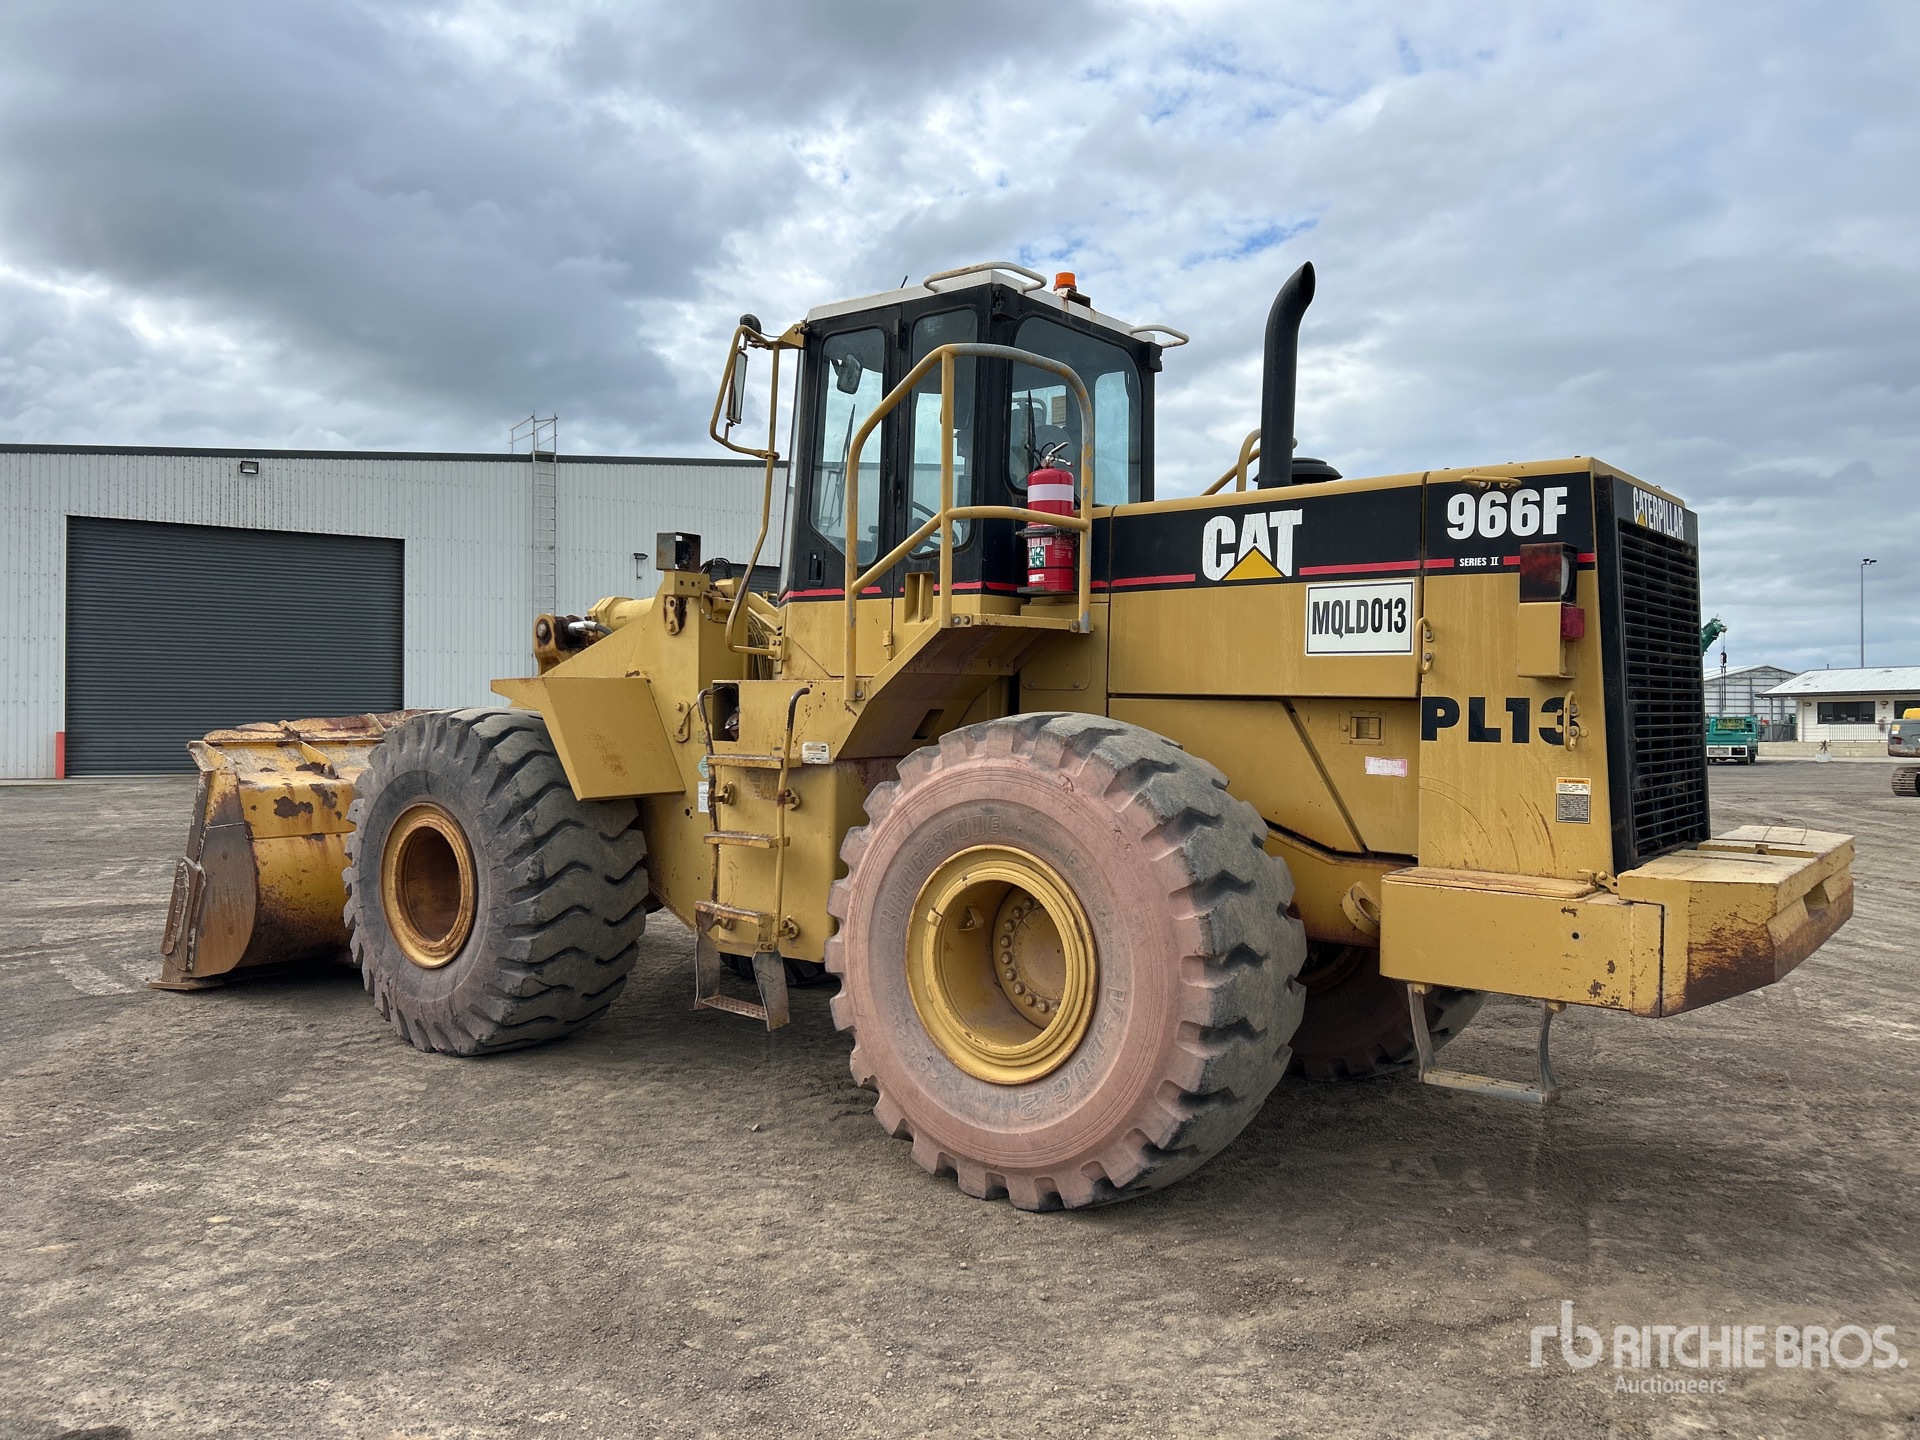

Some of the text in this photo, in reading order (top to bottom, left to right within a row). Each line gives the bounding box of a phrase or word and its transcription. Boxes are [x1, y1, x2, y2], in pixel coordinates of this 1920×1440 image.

[1446, 486, 1568, 540] 966F
[1632, 486, 1684, 541] CATERPILLAR
[1201, 508, 1303, 582] CAT
[1459, 556, 1500, 567] SERIES II
[1311, 597, 1407, 639] MQLD013
[1420, 696, 1579, 746] PL13
[880, 814, 1001, 939] BRIDGESTONE
